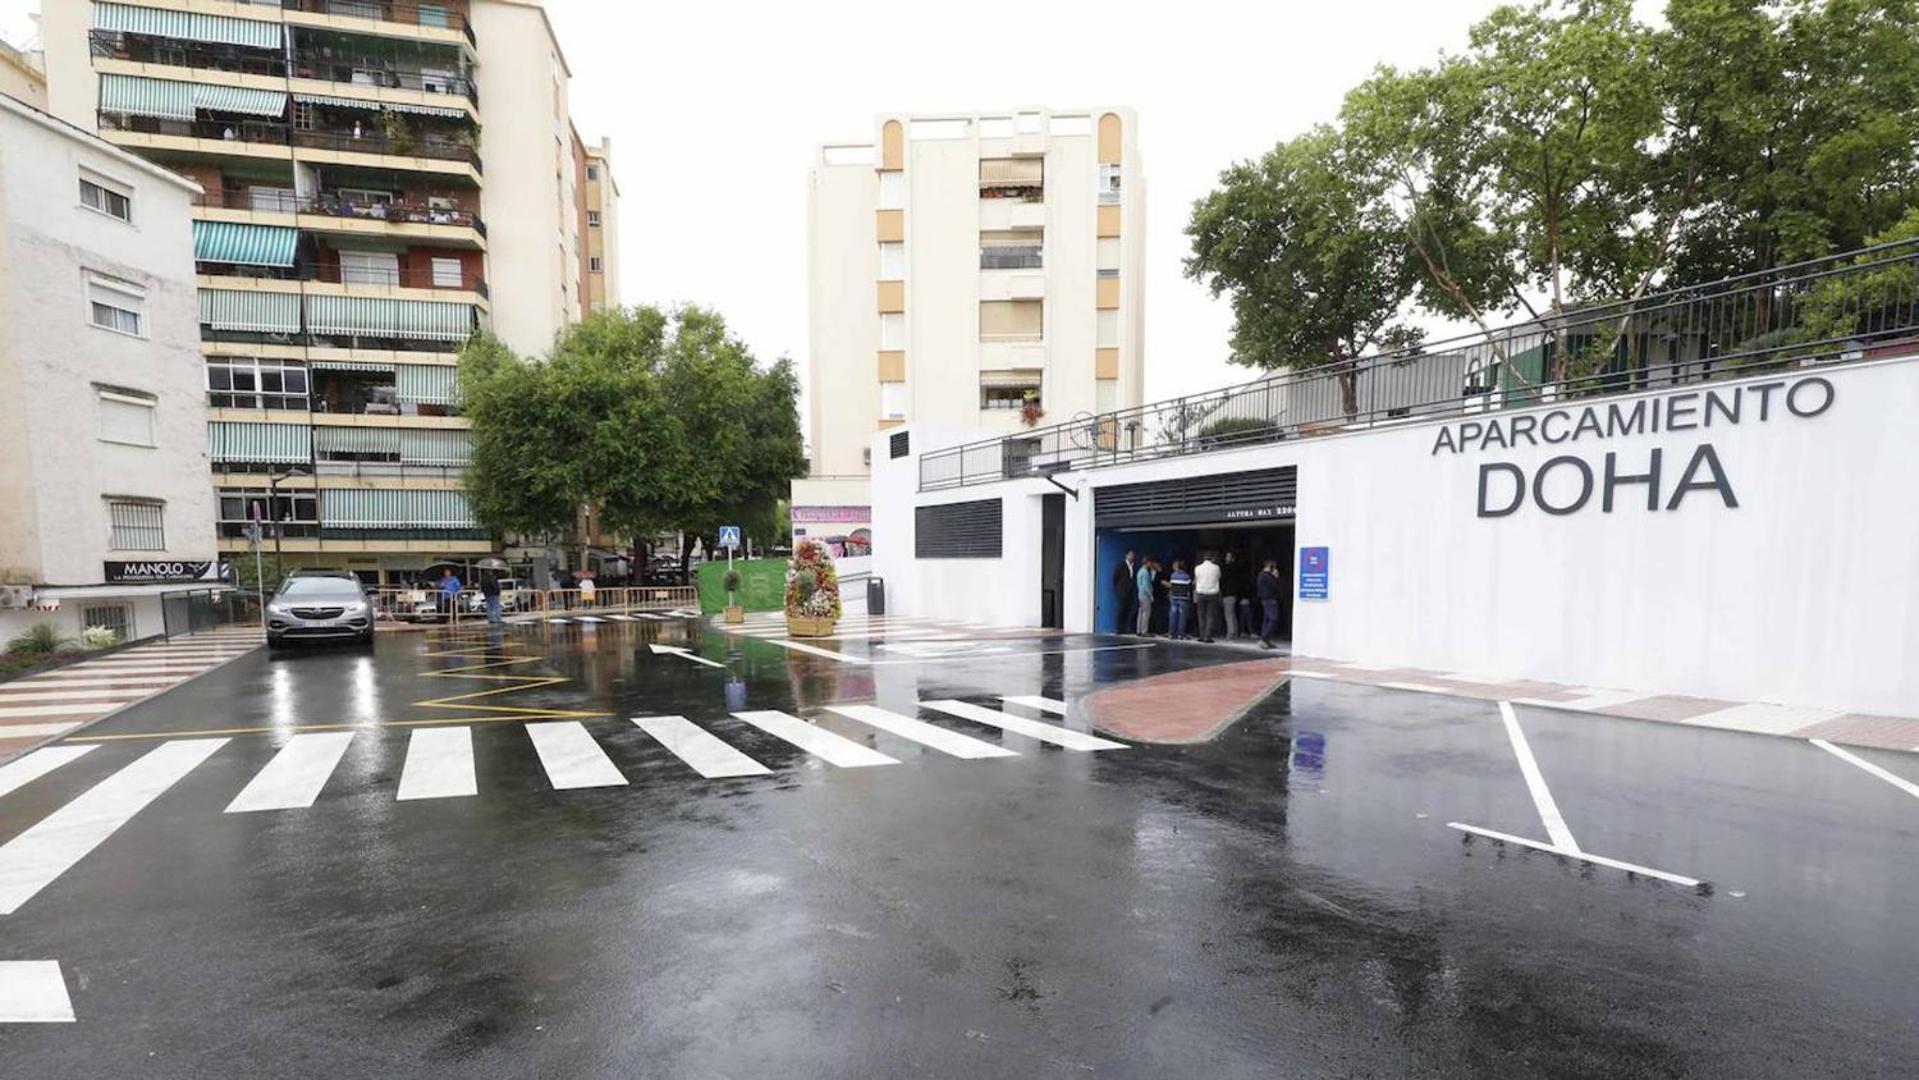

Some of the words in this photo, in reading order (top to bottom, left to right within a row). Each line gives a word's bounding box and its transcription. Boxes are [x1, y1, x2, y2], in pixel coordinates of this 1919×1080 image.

[1432, 377, 1835, 456] APARCAMIENTO
[1477, 443, 1739, 518] DOHA
[124, 563, 183, 575] MANOLO
